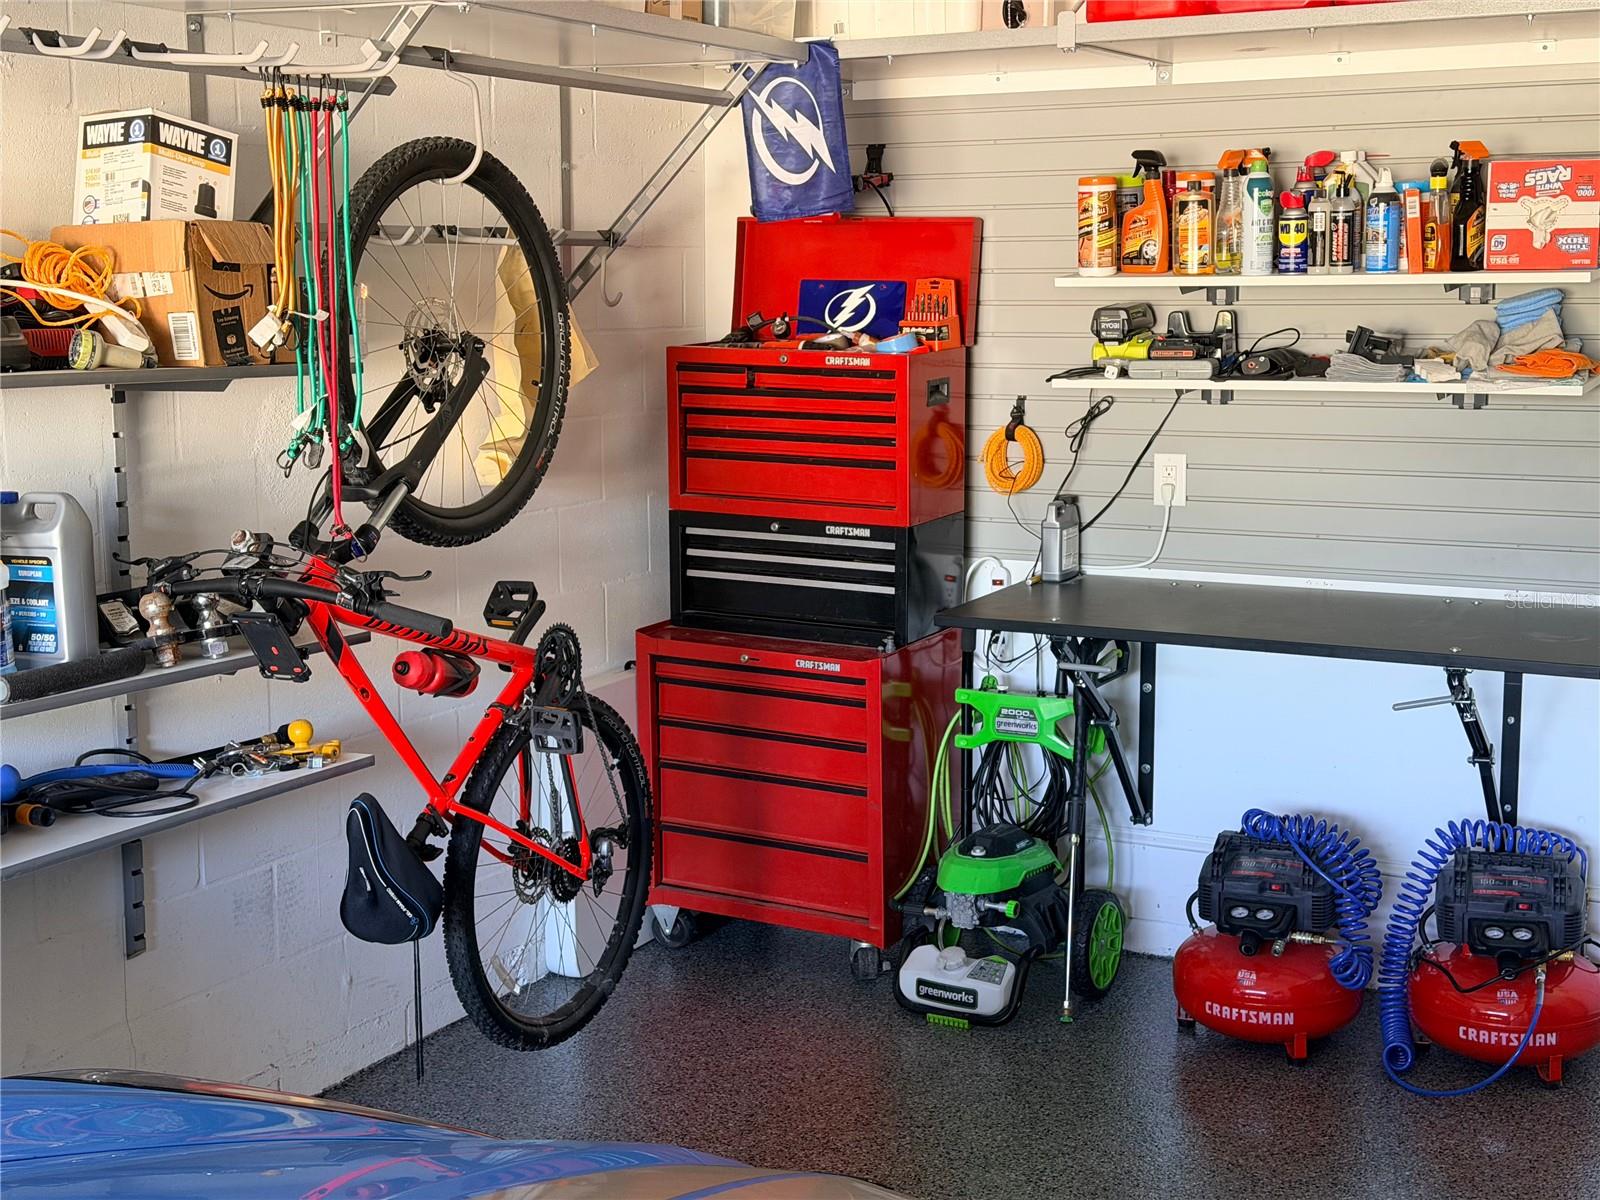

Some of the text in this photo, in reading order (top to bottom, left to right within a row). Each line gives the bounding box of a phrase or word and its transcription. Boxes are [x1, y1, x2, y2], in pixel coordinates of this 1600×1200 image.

[86, 121, 126, 146] WAYNE
[159, 121, 207, 155] WAYNE
[1524, 164, 1572, 188] RAGS
[1535, 182, 1564, 192] WHITE
[1280, 222, 1305, 235] WD40
[825, 356, 871, 366] CRAFTSMAN
[546, 311, 568, 438] GROUND CONTROL
[825, 525, 871, 538] CRAFTSMAN
[31, 633, 56, 642] 50/50
[795, 659, 841, 672] CRAFTSMAN
[1001, 708, 1030, 717] 2000
[996, 720, 1038, 730] greenworks
[919, 984, 975, 1004] greenworks
[1496, 990, 1519, 998] USA
[1205, 1000, 1295, 1025] CRAFTSMAN
